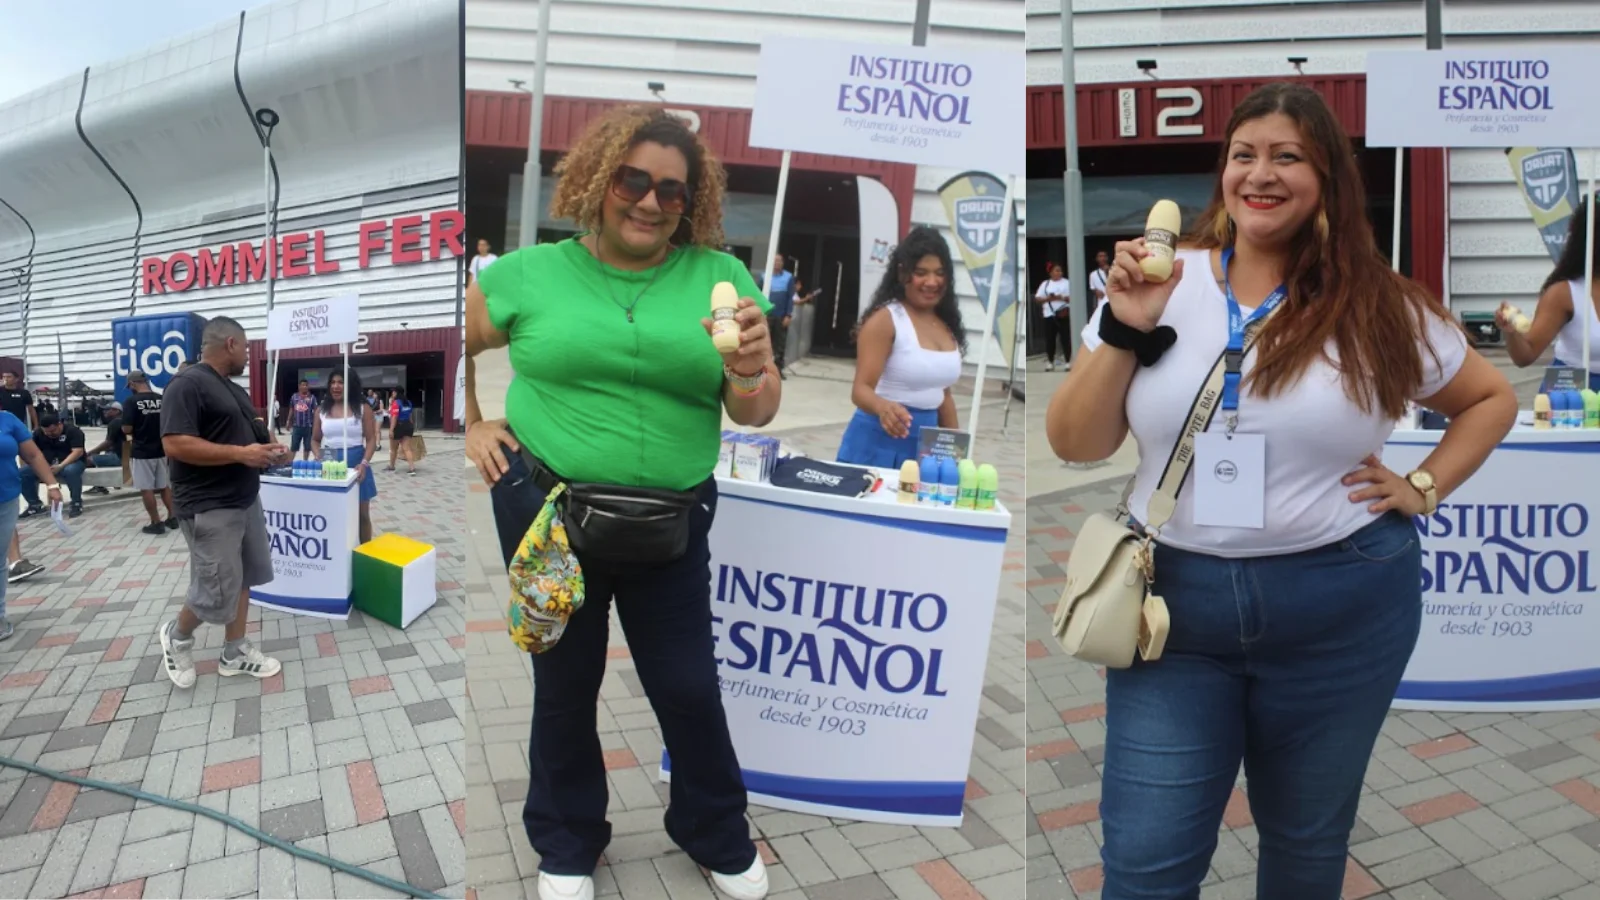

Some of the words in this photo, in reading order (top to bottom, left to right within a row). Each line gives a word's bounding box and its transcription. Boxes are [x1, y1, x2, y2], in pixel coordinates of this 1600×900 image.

[849, 55, 972, 87] INSTITUTO
[1445, 60, 1549, 82] INSTITUTO
[837, 83, 972, 125] ESPAÑOL
[1438, 83, 1554, 110] ESPAÑOL
[870, 133, 899, 144] desde
[901, 136, 929, 148] 1903
[899, 124, 908, 134] y
[1496, 124, 1520, 133] 1903
[142, 230, 340, 294] ROMMEL
[359, 210, 464, 269] FER
[289, 316, 329, 332] ESPAÑOL
[292, 304, 329, 319] INSTITUTO
[1176, 443, 1193, 463] THE
[1186, 413, 1206, 438] TOTE
[1200, 389, 1216, 410] BAG
[716, 564, 948, 633] INSTITUTO
[1485, 604, 1498, 620] y
[1502, 600, 1584, 617] Cosmética
[1440, 621, 1485, 635] desde
[1491, 621, 1533, 637] 1903
[711, 615, 948, 697] ESPAÑOL
[759, 706, 812, 727] desde
[817, 715, 867, 736] 1903
[811, 696, 828, 712] y
[832, 696, 929, 721] Cosmética
